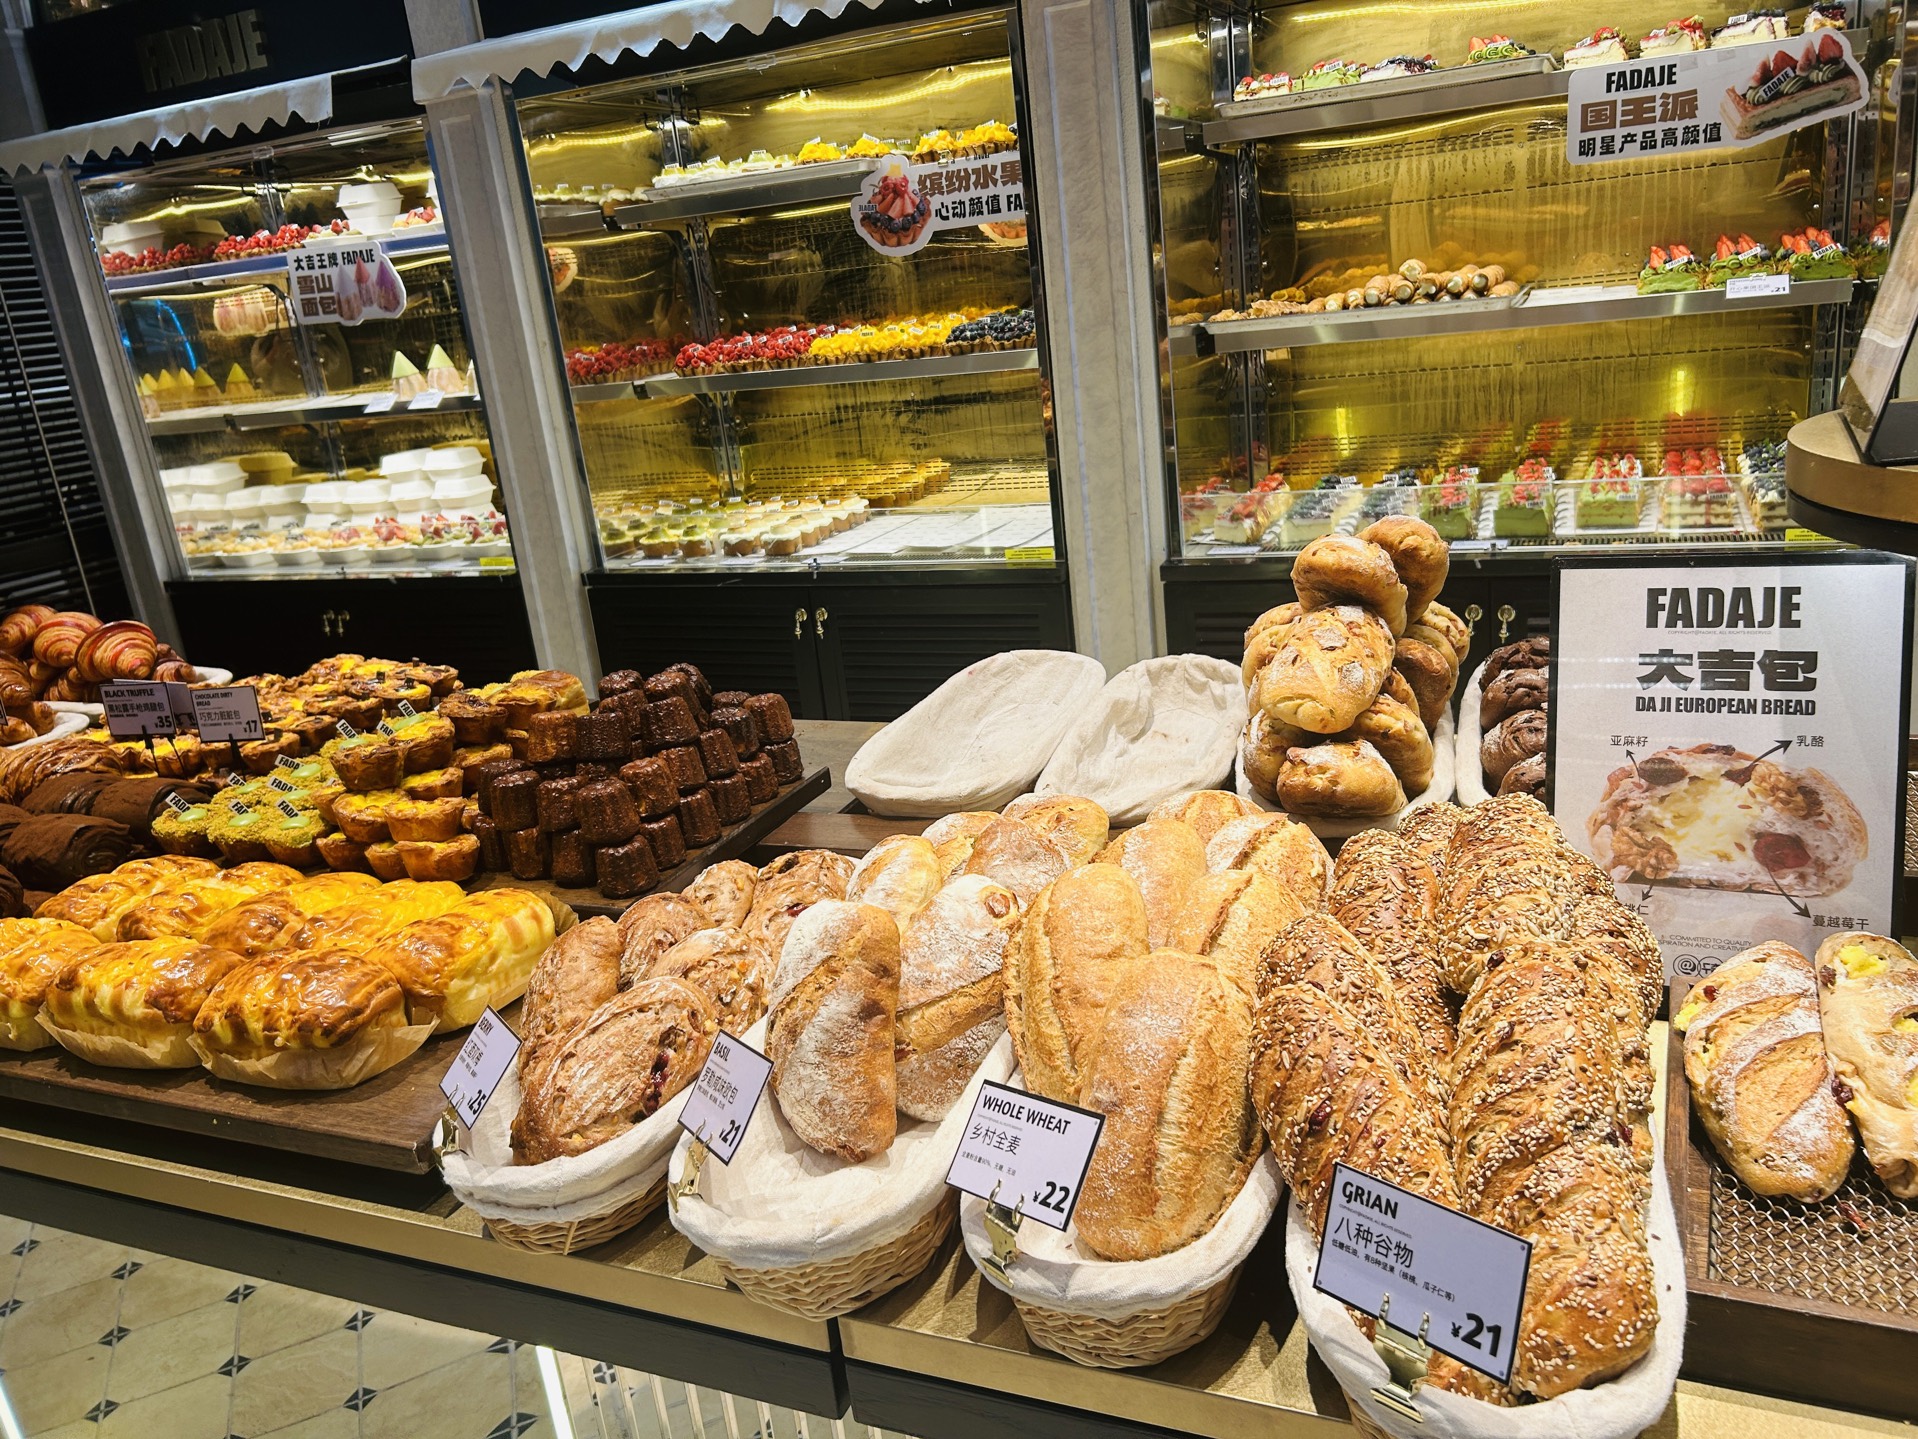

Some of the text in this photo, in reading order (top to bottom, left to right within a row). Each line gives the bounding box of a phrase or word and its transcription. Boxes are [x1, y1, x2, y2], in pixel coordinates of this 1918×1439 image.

[135, 8, 268, 93] FADAJE
[1605, 63, 1677, 93] FADAJE
[1763, 69, 1792, 98] FADAJE
[1580, 89, 1698, 133] 国王派
[1578, 121, 1722, 157] 明星产品高颜值
[917, 160, 1023, 197] 缤纷水果
[935, 194, 1002, 221] 心动颜值
[294, 252, 339, 272] 大吉王牌
[296, 273, 334, 295] 雪山
[300, 295, 337, 317] 面包
[1645, 586, 1802, 629] FADAJE
[1635, 648, 1818, 691] 大吉包
[104, 688, 155, 698] BLACK TRUFFLE
[1635, 696, 1816, 715] DA JI EUROPEAN BREAD
[155, 715, 173, 729] ¥35
[243, 720, 258, 733] ¥17
[1610, 735, 1648, 747] 亚麻籽
[1795, 735, 1825, 748] 乳酪
[1812, 915, 1869, 930] 蔓越莓干
[1669, 934, 1711, 943] COMMITTED
[1723, 938, 1752, 946] QUALITY
[713, 1041, 731, 1062] BASIL
[467, 1089, 487, 1115] ¥25
[982, 1094, 1026, 1120] WHOLE
[1026, 1108, 1071, 1135] WHEAT
[719, 1119, 742, 1147] ¥21
[969, 1122, 1022, 1156] 乡村全麦
[1032, 1181, 1070, 1214] ¥22
[1341, 1180, 1399, 1220] GRIAN
[1334, 1216, 1414, 1269] 八种谷物
[1450, 1312, 1502, 1358] ¥21
